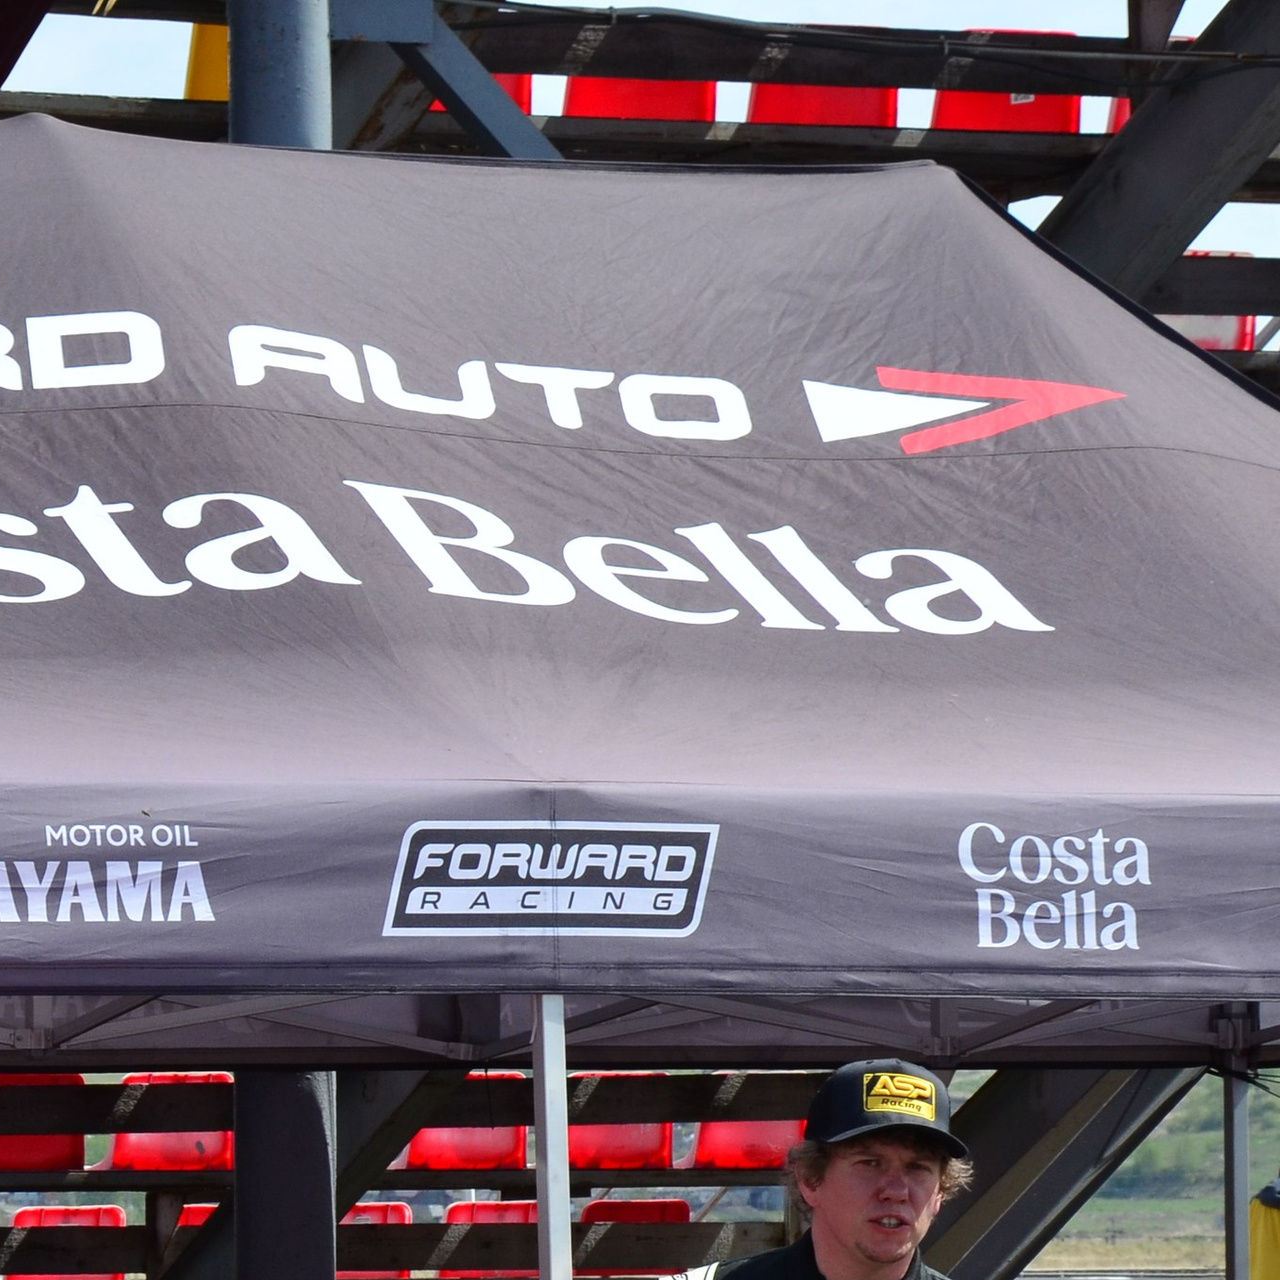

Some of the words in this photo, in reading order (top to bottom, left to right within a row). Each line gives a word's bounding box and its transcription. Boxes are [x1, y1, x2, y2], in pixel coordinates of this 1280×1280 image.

[228, 325, 752, 441] AUTO
[342, 480, 1056, 636] Bella
[45, 824, 145, 847] MOTOR
[150, 824, 199, 847] OIL
[957, 822, 1153, 886] Costa
[413, 843, 697, 882] FORWARD
[420, 890, 675, 911] RACING
[975, 887, 1141, 951] Bella
[870, 1075, 932, 1099] ASP
[881, 1098, 922, 1112] Racing
